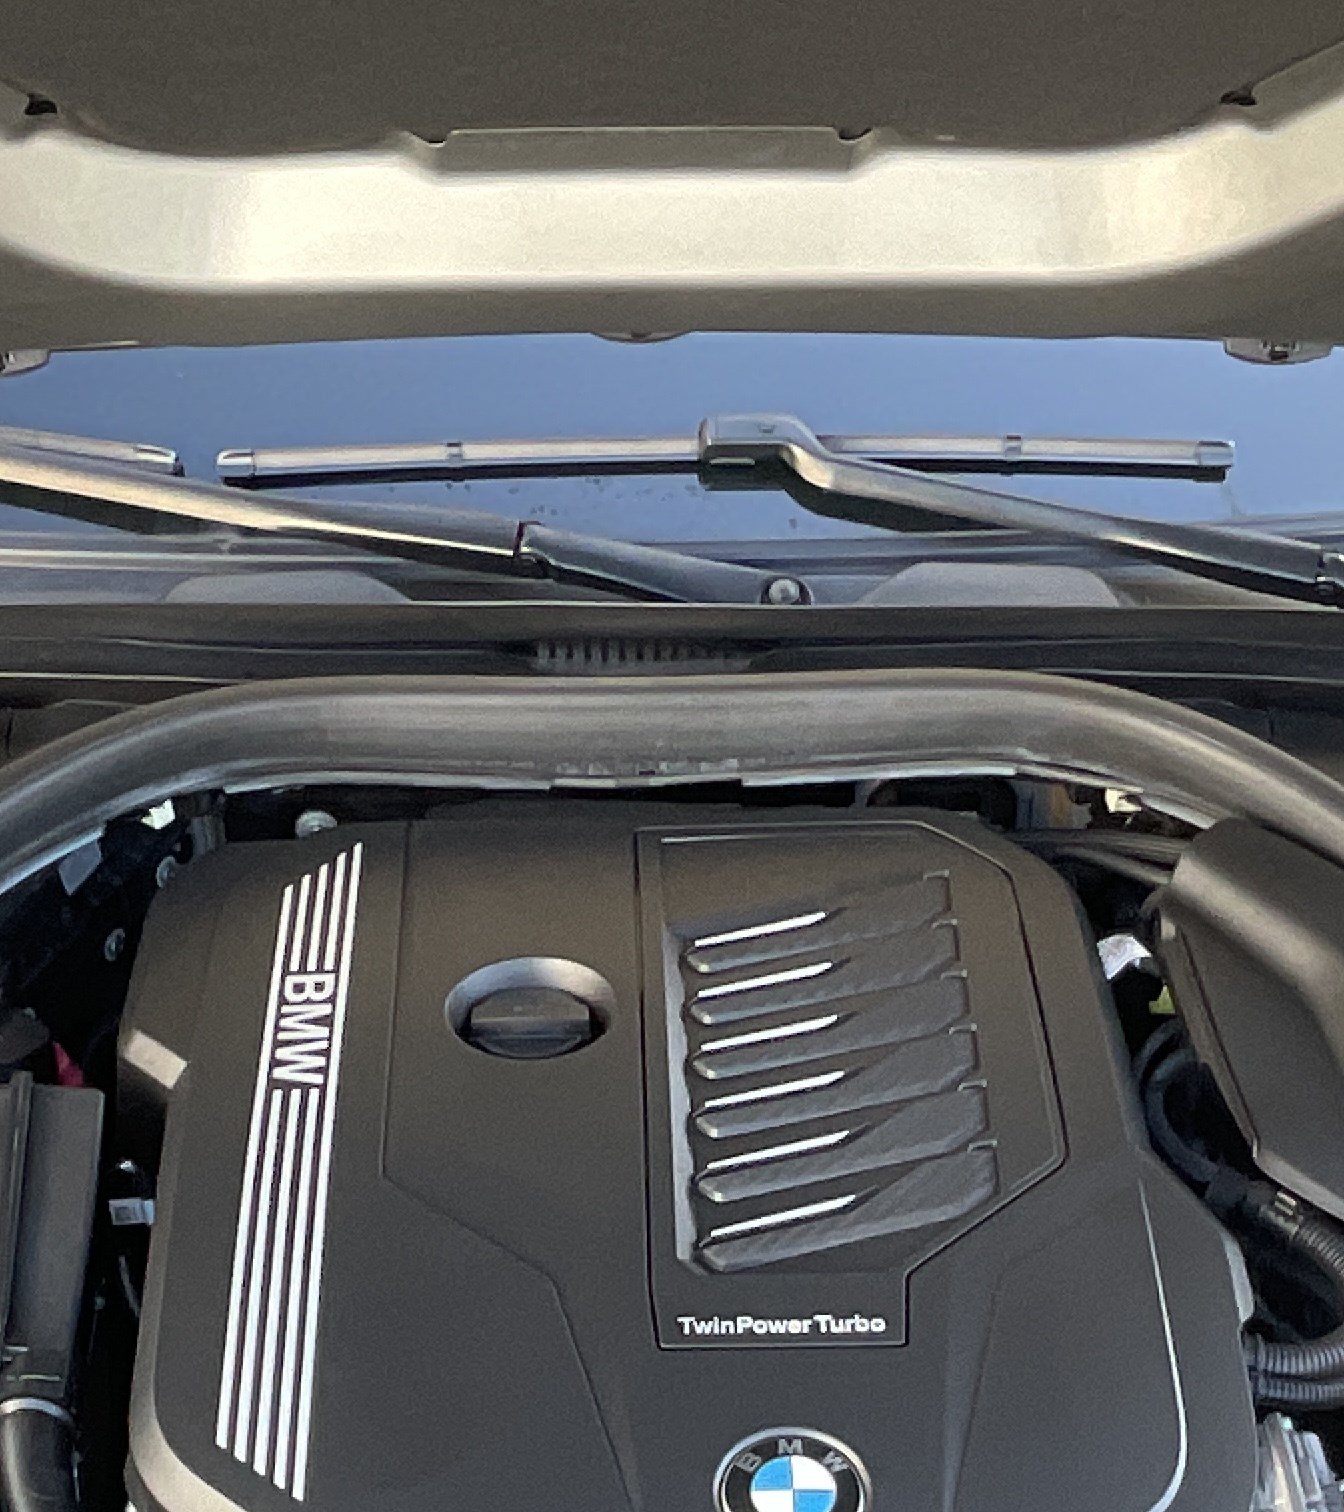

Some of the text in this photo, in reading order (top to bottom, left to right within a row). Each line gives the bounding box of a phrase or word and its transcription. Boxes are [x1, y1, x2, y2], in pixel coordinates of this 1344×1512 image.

[272, 973, 335, 1084] BMW
[677, 1313, 886, 1335] TwinPower Turbo
[734, 1438, 850, 1473] BMW
